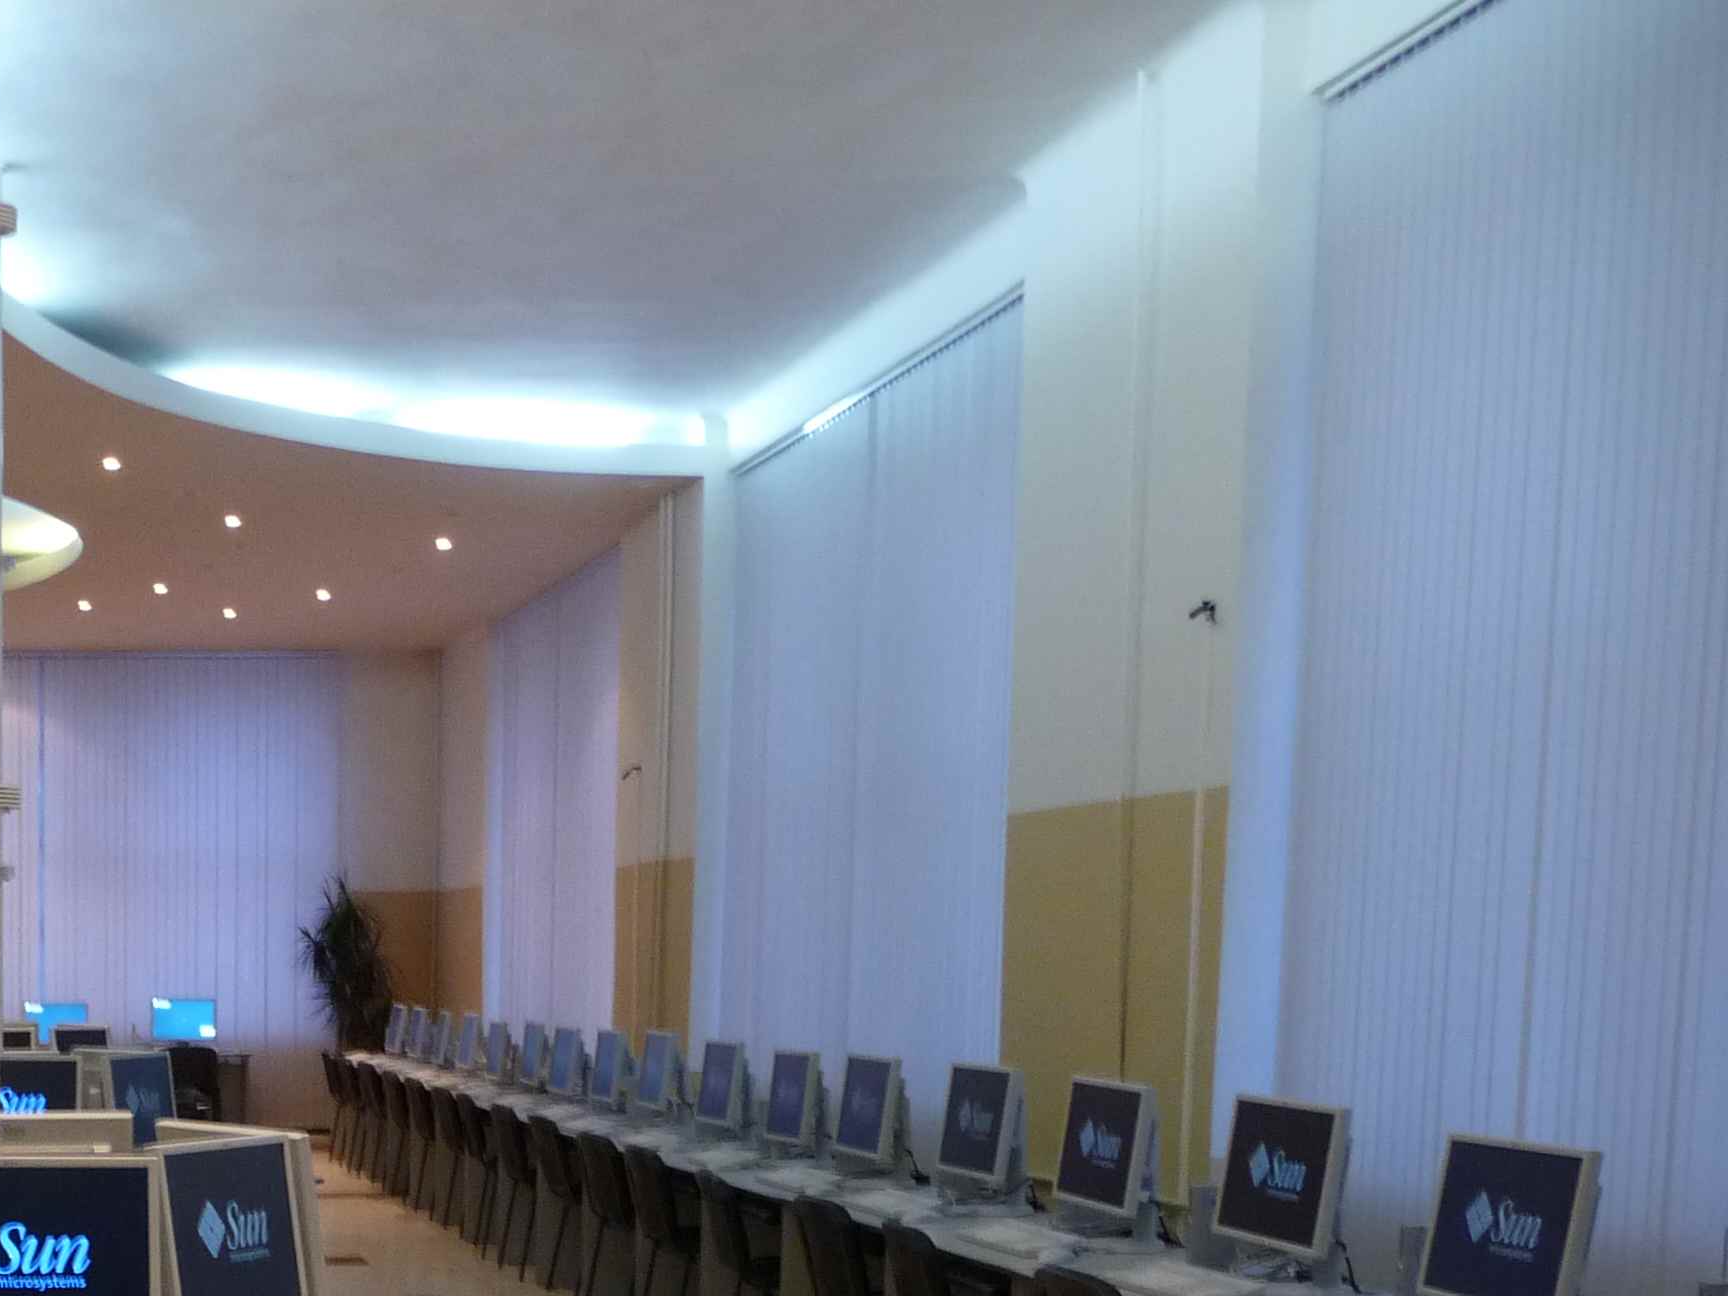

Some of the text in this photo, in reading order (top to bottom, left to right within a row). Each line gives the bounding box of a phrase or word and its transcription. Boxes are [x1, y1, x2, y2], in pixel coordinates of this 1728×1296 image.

[0, 1086, 46, 1114] Sun
[1267, 1150, 1306, 1192] Sun
[226, 1200, 268, 1250] Sun
[1491, 1199, 1542, 1249] Sun
